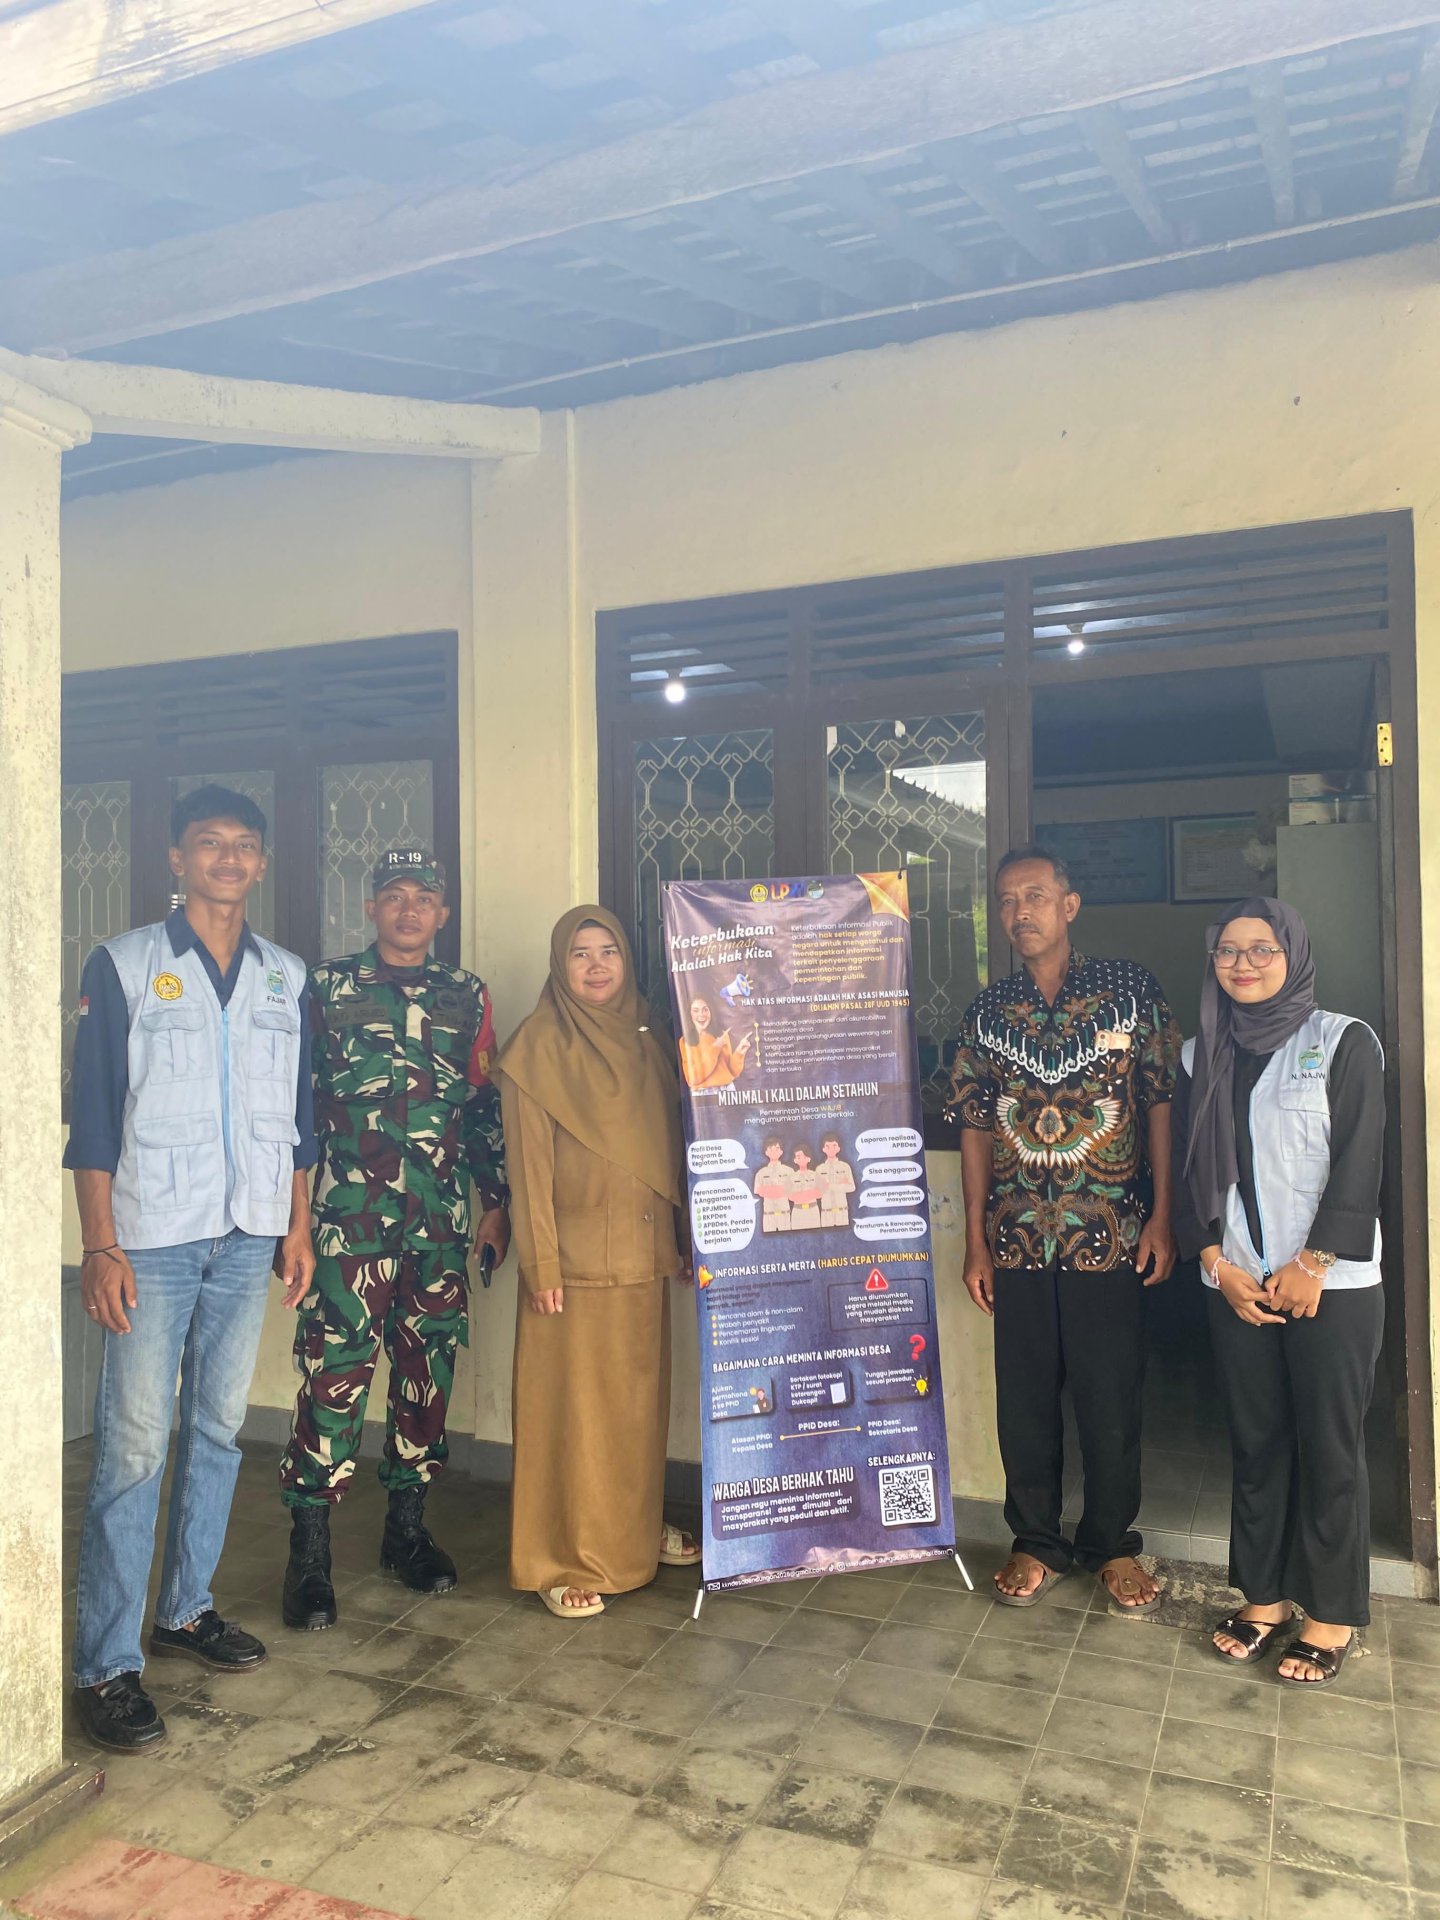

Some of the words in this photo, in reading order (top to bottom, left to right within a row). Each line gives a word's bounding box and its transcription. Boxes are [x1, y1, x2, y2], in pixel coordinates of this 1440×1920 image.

[791, 922, 836, 932] Keterbukaan
[838, 920, 871, 929] Informasi
[872, 919, 893, 927] Publik
[671, 924, 774, 950] Keterbukaan
[818, 931, 833, 939] hak
[834, 929, 857, 939] setiap
[858, 929, 882, 938] warga
[693, 938, 757, 959] informasi
[792, 941, 819, 950] negara
[820, 940, 841, 948] untuk
[843, 937, 888, 947] mengetahui
[889, 936, 904, 944] dan
[793, 947, 846, 958] mendapatkan
[846, 945, 882, 956] informasi
[672, 955, 715, 973] Adalah
[718, 950, 742, 965] Hak
[745, 946, 773, 960] Kita
[793, 958, 819, 967] terkait
[793, 965, 847, 976] pemerintahan
[848, 964, 863, 972] dan
[794, 974, 841, 985] kepentingan
[742, 998, 756, 1007] HAK
[757, 996, 775, 1006] ATAS
[776, 995, 813, 1005] INFORMASI
[814, 993, 841, 1002] ADALAH
[841, 991, 856, 1000] HAK
[857, 990, 878, 999] ASASI
[878, 989, 910, 998] MANUSIA
[841, 1001, 863, 1010] PASAL
[876, 999, 891, 1008] UUD
[892, 998, 910, 1007] 1945)
[848, 1029, 880, 1038] wewenang
[846, 1045, 881, 1053] masyarakat
[862, 1052, 877, 1060] yang
[766, 1066, 779, 1074] dan
[780, 1064, 802, 1073] terbuka
[718, 1090, 763, 1106] MINIMAL
[771, 1087, 794, 1103] KALI
[796, 1085, 830, 1101] DALAM
[832, 1082, 879, 1098] SETAHUN
[759, 1107, 800, 1117] Pemerintah
[801, 1106, 819, 1114] Desa
[744, 1115, 801, 1126] mengumumkan
[802, 1113, 827, 1121] secara
[861, 1137, 888, 1145] Laporan
[888, 1134, 917, 1142] realisasi
[892, 1141, 917, 1149] APBDes
[691, 1153, 717, 1161] Program
[692, 1160, 718, 1168] Kegiatan
[883, 1166, 917, 1175] anggaran
[694, 1188, 735, 1196] Perencanaan
[888, 1189, 921, 1198] pengaduan
[886, 1196, 921, 1204] masyarakat
[702, 1205, 732, 1213] RPJMDes
[702, 1213, 727, 1221] RKPDes
[731, 1218, 754, 1226] Perdes
[856, 1222, 884, 1230] Peraturan
[890, 1220, 924, 1229] Rancangan
[704, 1229, 728, 1237] APBDes
[704, 1236, 732, 1245] berjalan
[715, 1266, 759, 1279] INFORMASI
[760, 1263, 787, 1274] SERTA
[788, 1260, 816, 1272] MERTA
[817, 1257, 849, 1269] (HARUS
[850, 1255, 876, 1266] CEPAT
[877, 1251, 929, 1263] DIUMUMKAN)
[848, 1295, 868, 1303] Harus
[868, 1292, 909, 1301] diumumkan
[844, 1303, 867, 1312] segera
[892, 1298, 914, 1306] media
[718, 1311, 746, 1321] Bencana
[746, 1309, 764, 1317] alam
[771, 1306, 804, 1315] non-alam
[846, 1311, 863, 1320] yang
[863, 1308, 888, 1316] mudah
[888, 1306, 913, 1314] diakses
[718, 1320, 741, 1329] Wabah
[742, 1318, 770, 1328] penyakit
[860, 1314, 900, 1324] masyarakat
[719, 1328, 760, 1338] Pencemaran
[760, 1324, 796, 1335] lingkungan
[719, 1338, 739, 1347] Konflik
[740, 1335, 760, 1344] sosial
[712, 1358, 760, 1373] BAGAIMANA
[761, 1356, 785, 1367] CARA
[786, 1352, 822, 1364] MEMINTA
[824, 1347, 868, 1360] INFORMASI
[869, 1345, 891, 1356] DESA
[790, 1374, 817, 1383] Sertakan
[817, 1371, 843, 1380] fotokopi
[865, 1370, 888, 1379] Tunggu
[888, 1368, 915, 1377] jawaban
[806, 1381, 823, 1389] surat
[866, 1378, 885, 1386] sesuai
[886, 1375, 913, 1385] prosedur
[711, 1385, 733, 1394] Ajukan
[791, 1389, 826, 1399] keterangan
[792, 1397, 818, 1406] Dukcapil
[712, 1410, 728, 1419] Desa
[798, 1422, 817, 1431] PPID
[867, 1420, 882, 1428] PPID
[868, 1428, 901, 1437] Sekretaris
[902, 1425, 918, 1433] Desa
[731, 1436, 756, 1444] Atasan
[732, 1445, 756, 1454] Kepala
[756, 1442, 773, 1450] Desa
[868, 1451, 936, 1467] SELENGKAPNYA:
[712, 1481, 751, 1501] WARGA
[752, 1476, 780, 1496] DESA
[781, 1470, 824, 1491] BERHAK
[825, 1466, 854, 1485] TAHU
[721, 1503, 750, 1515] Jangan
[751, 1501, 769, 1511] ragu
[769, 1496, 805, 1506] meminta
[805, 1489, 843, 1500] informasi.
[721, 1508, 772, 1522] Transparansi
[777, 1506, 796, 1514] desa
[802, 1500, 831, 1511] dimulai
[836, 1496, 853, 1505] dari
[722, 1517, 769, 1531] masyarakat
[769, 1515, 789, 1526] yang
[790, 1511, 813, 1522] peduli
[814, 1509, 829, 1518] dan
[830, 1506, 850, 1515] aktif.
